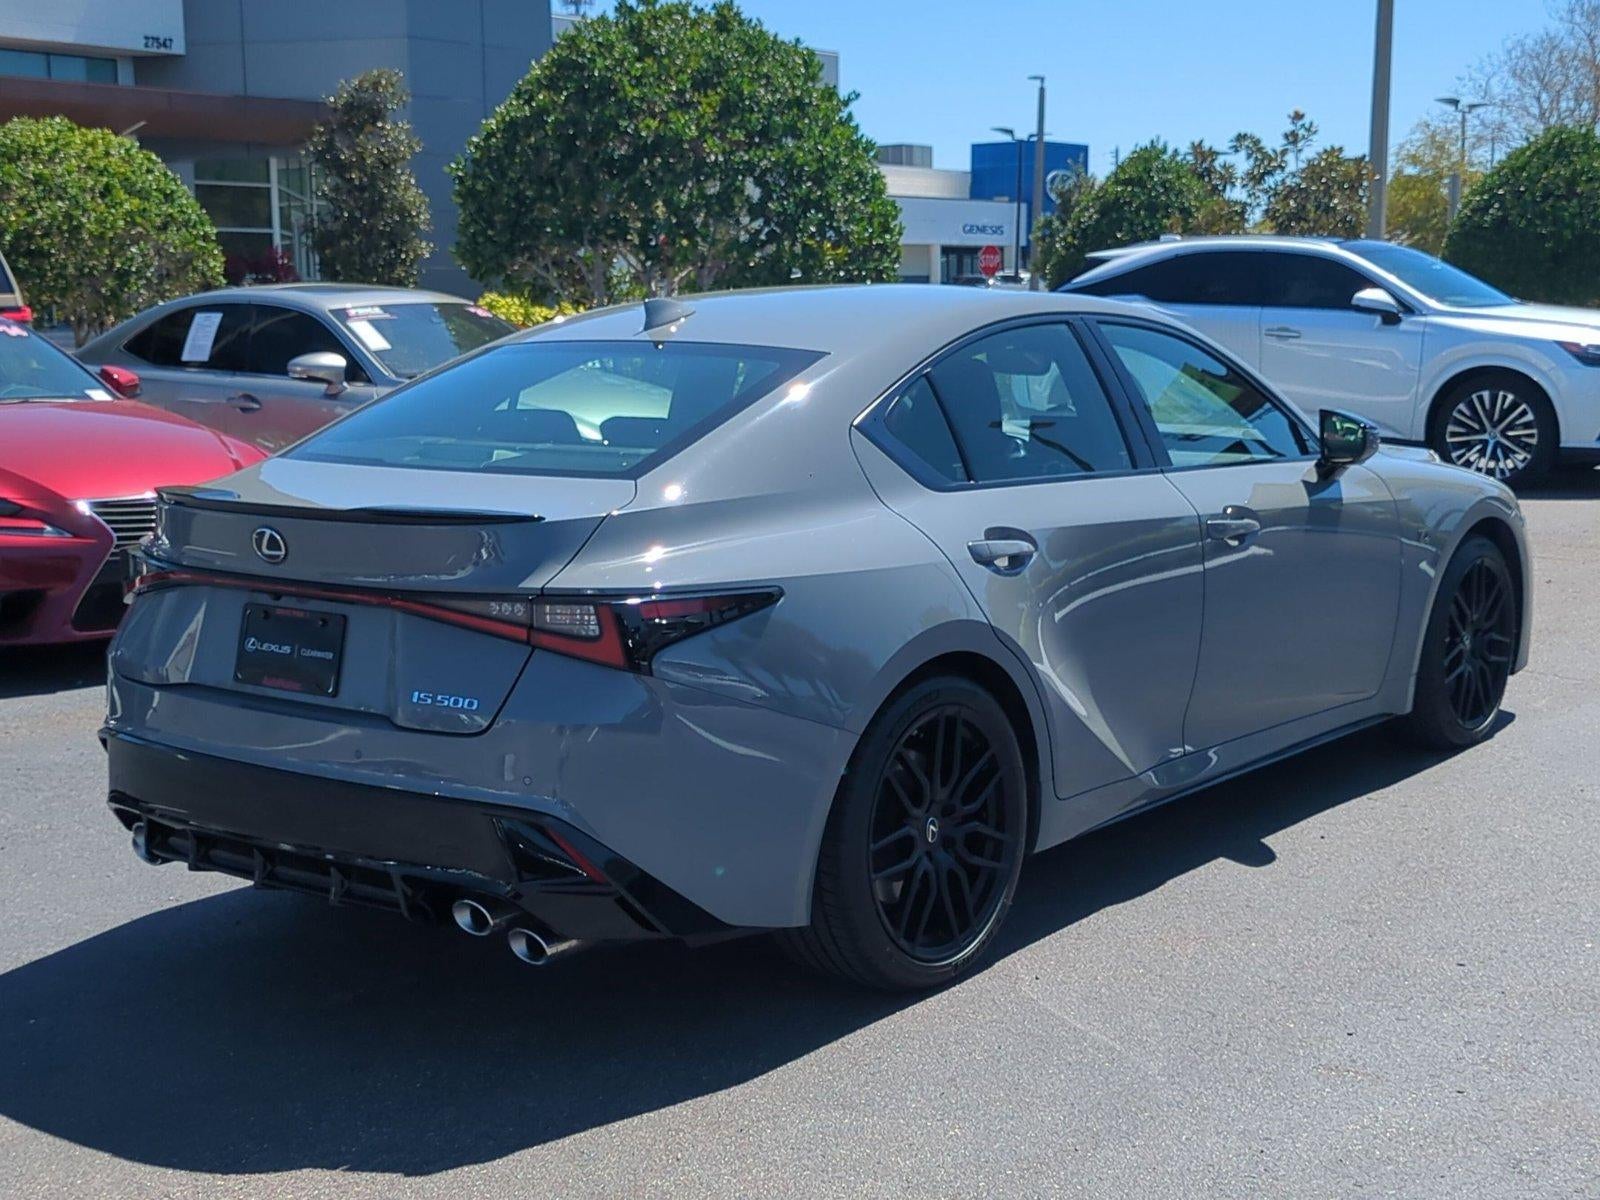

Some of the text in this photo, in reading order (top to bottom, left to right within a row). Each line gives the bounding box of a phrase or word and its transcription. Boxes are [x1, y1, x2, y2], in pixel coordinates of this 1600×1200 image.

[962, 223, 1004, 236] GENESIS
[979, 254, 1001, 268] STOP
[257, 641, 291, 654] LEXUS
[412, 691, 479, 711] IS 500
